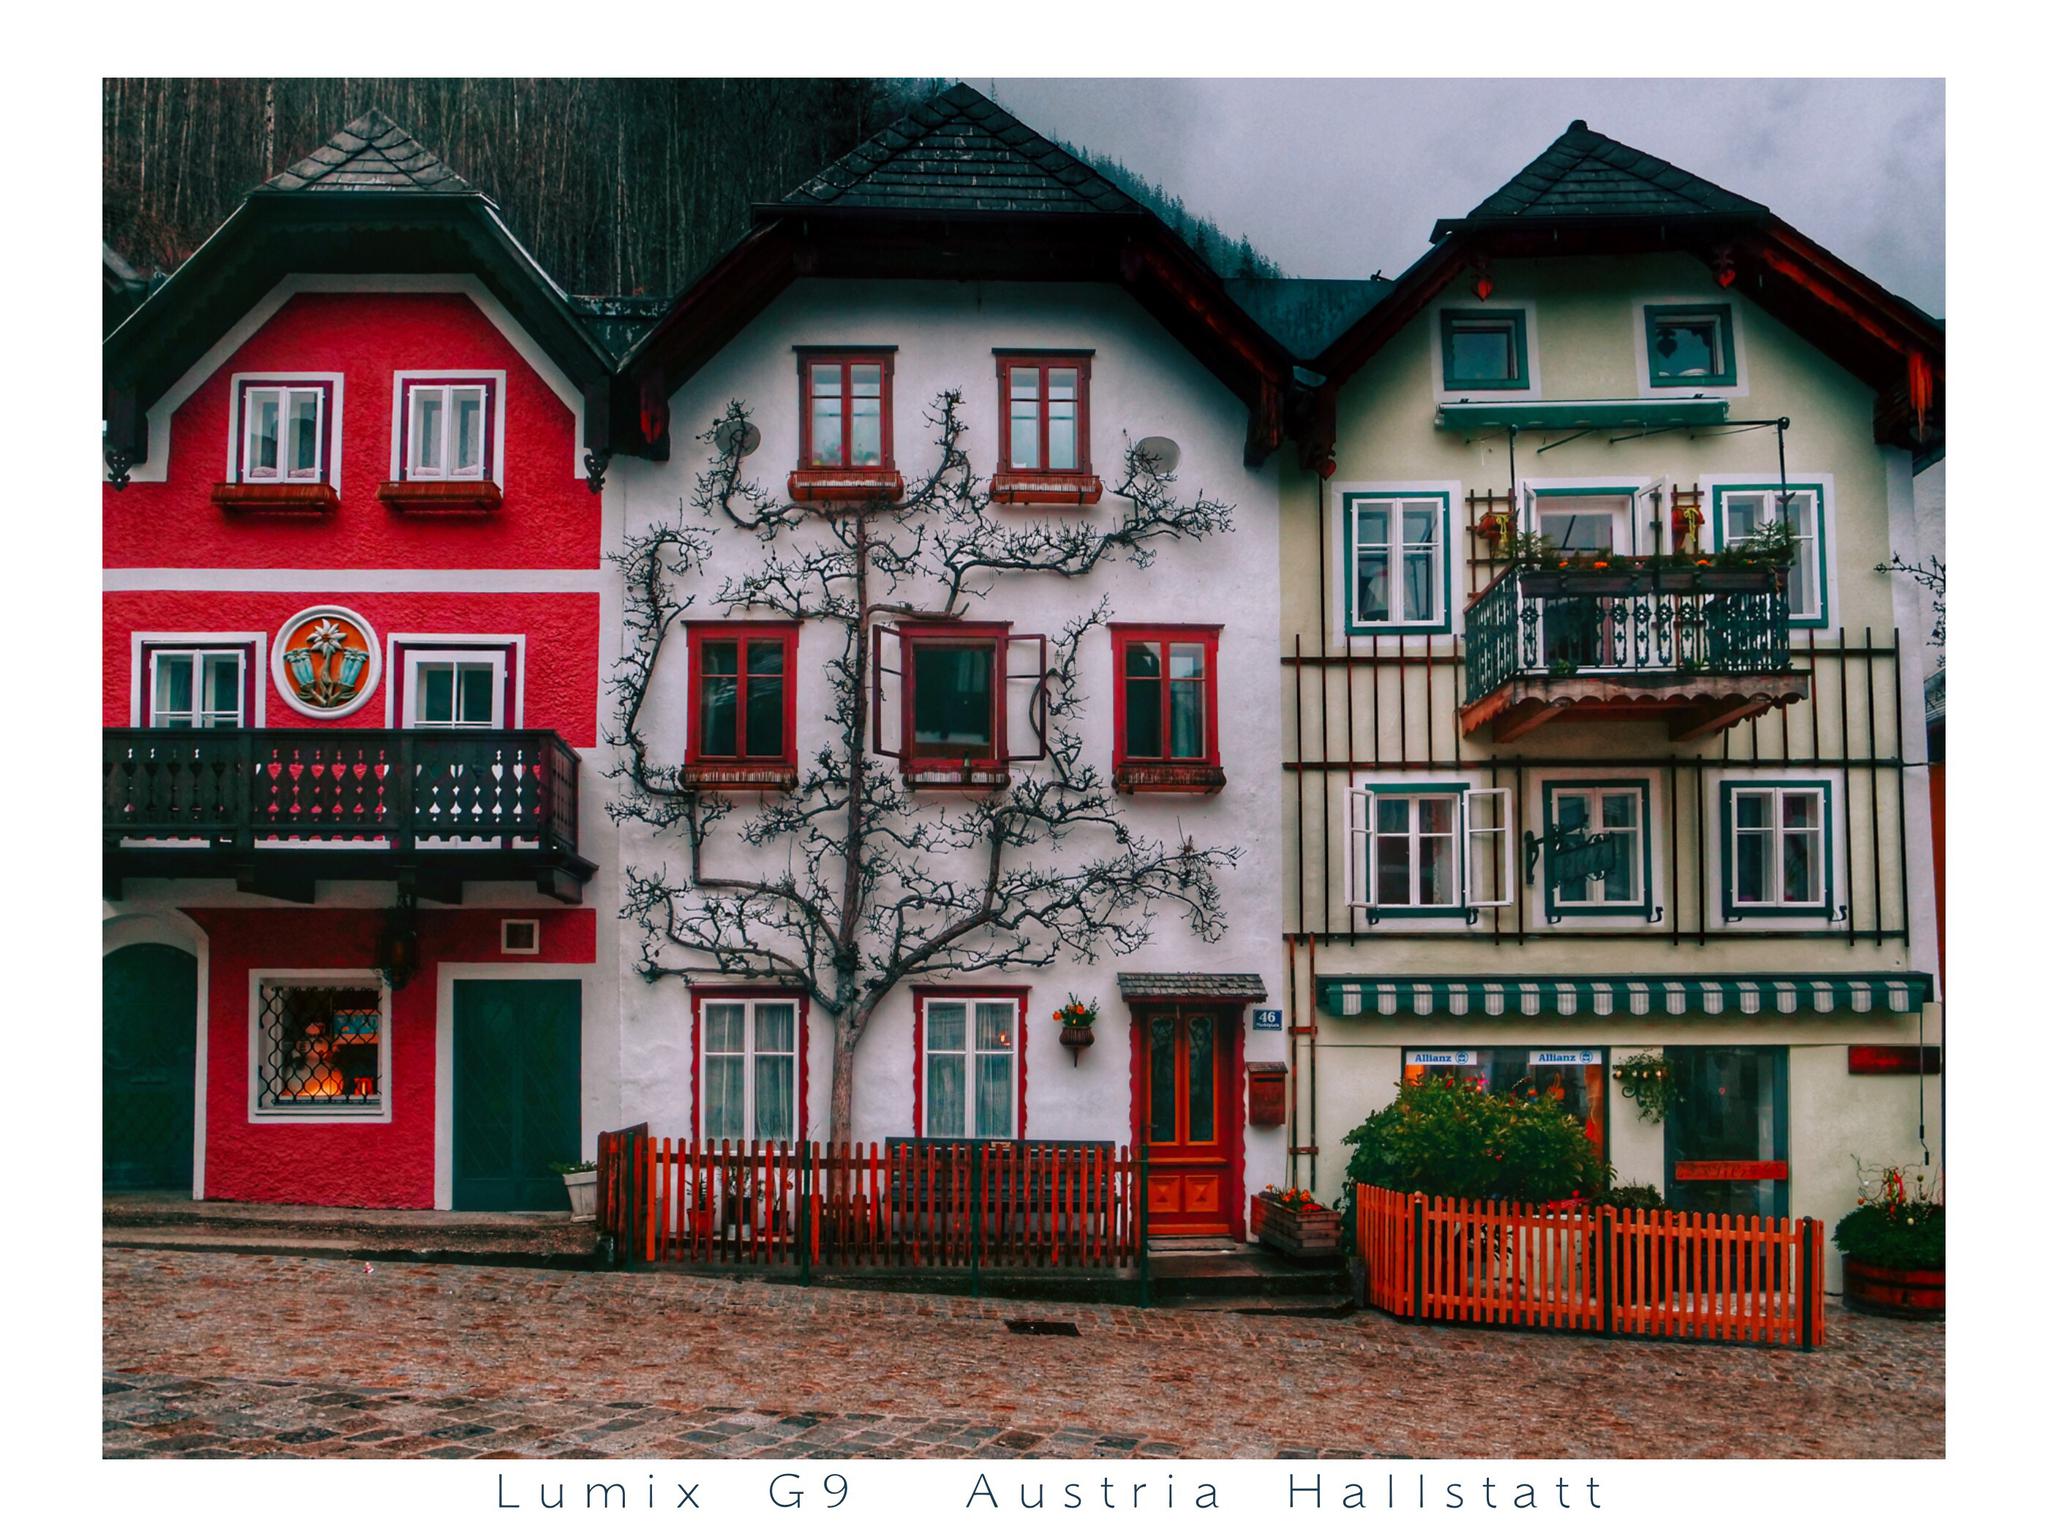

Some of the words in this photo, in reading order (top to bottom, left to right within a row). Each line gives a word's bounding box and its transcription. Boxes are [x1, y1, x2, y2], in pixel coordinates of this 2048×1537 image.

[1258, 1011, 1276, 1023] 46
[1415, 1053, 1452, 1063] Allianz
[1538, 1053, 1576, 1062] Allianz
